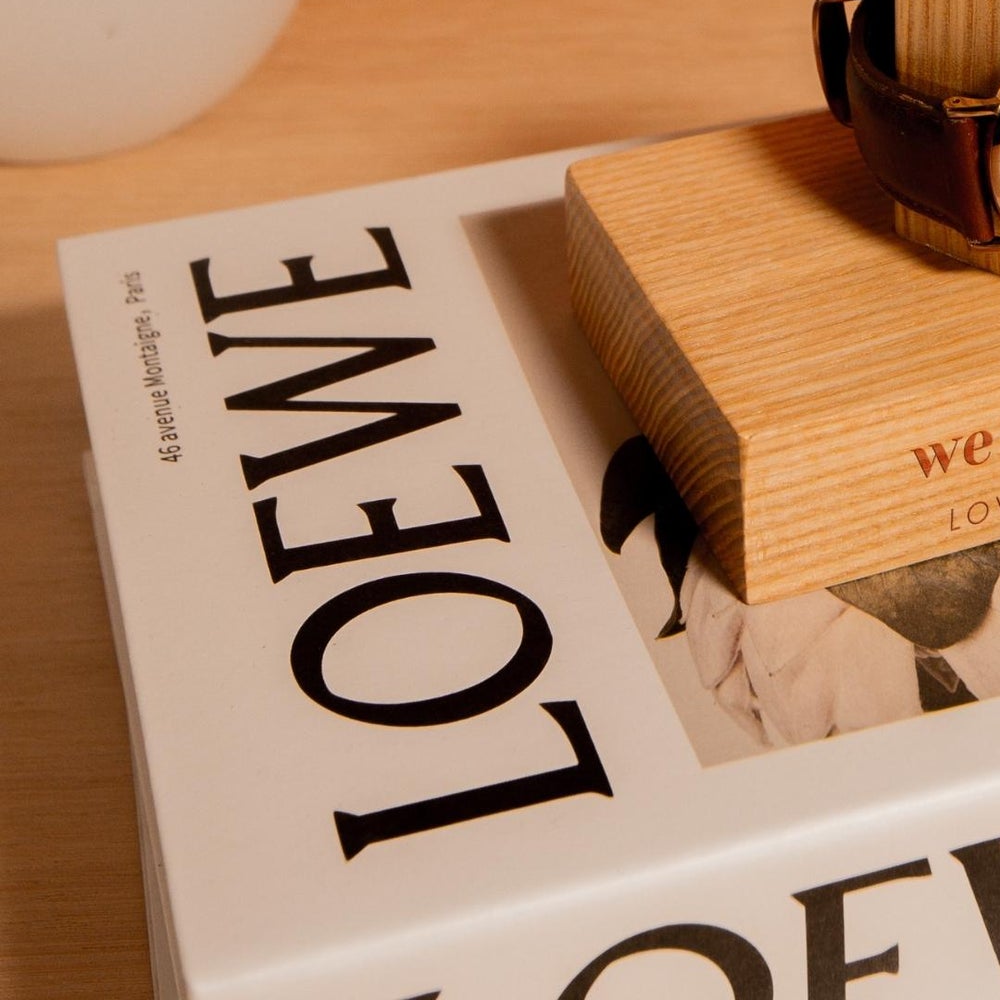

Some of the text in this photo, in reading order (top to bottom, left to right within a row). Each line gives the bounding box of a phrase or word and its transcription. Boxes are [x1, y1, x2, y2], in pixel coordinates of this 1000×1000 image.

[119, 270, 183, 463] 46 avenue Montaigne, Paris
[910, 425, 993, 479] we
[189, 226, 614, 862] LOEWE
